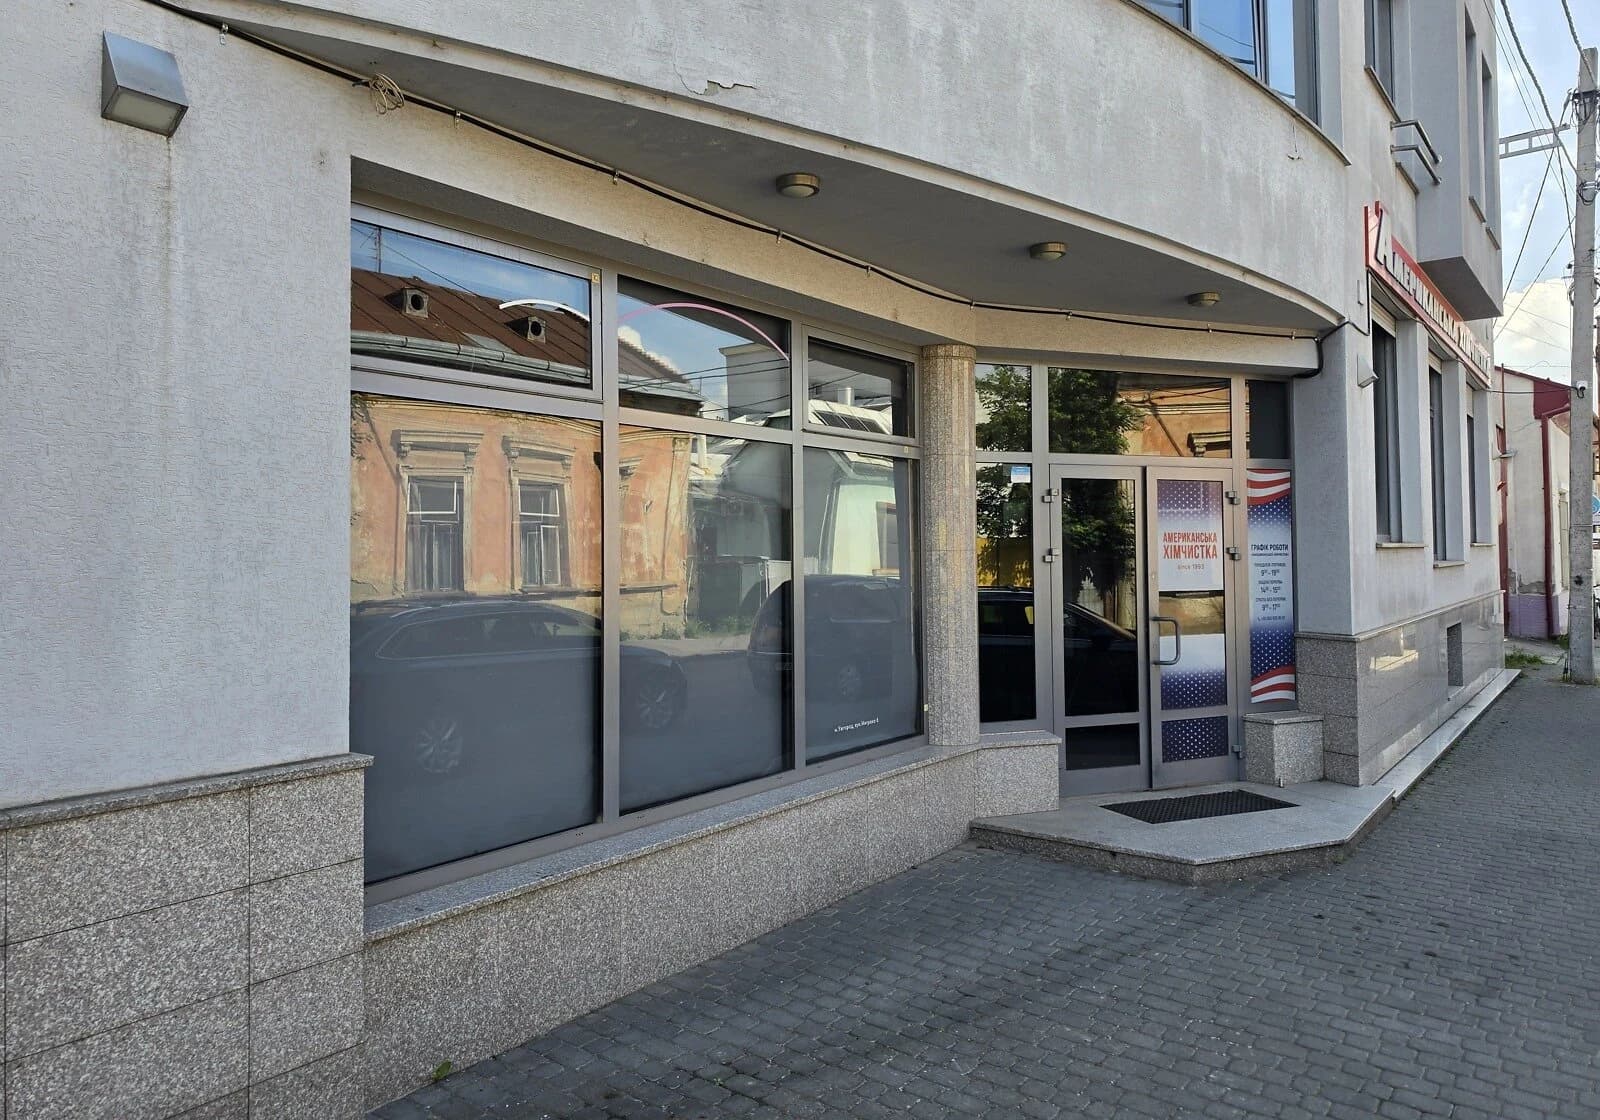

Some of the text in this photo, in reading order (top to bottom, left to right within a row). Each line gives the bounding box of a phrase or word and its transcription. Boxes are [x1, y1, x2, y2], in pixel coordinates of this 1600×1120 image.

[1163, 531, 1217, 543] АМЕРИКАНСЬКА
[1163, 544, 1217, 559] ХІМЧИСТКА
[1269, 543, 1289, 551] РОБОТИ
